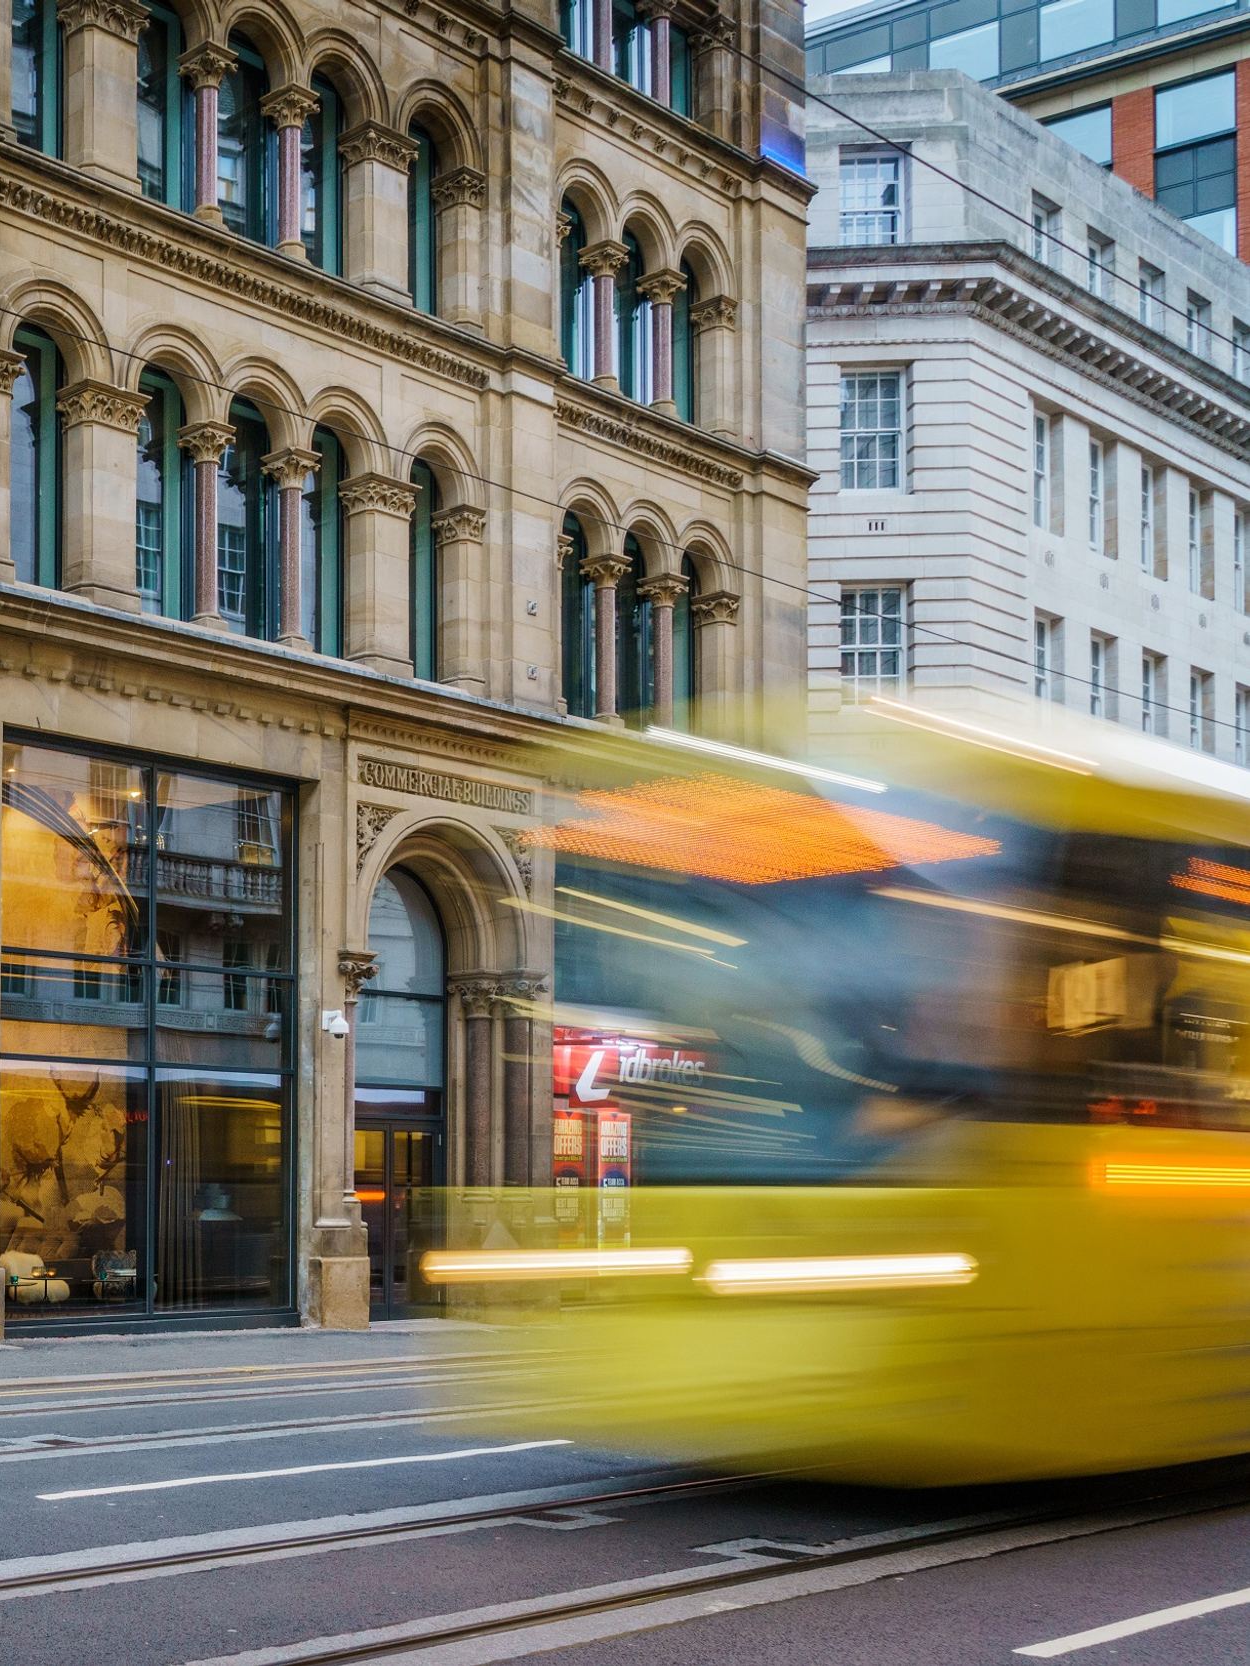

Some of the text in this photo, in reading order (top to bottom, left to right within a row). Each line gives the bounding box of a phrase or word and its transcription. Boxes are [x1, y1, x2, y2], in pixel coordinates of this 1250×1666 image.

[364, 760, 530, 812] COMMERCIAL BUILDINGS
[553, 1119, 582, 1134] AMAZING
[601, 1122, 628, 1137] AMAZING
[554, 1135, 583, 1155] OFFERS
[601, 1136, 628, 1157] OFFERS
